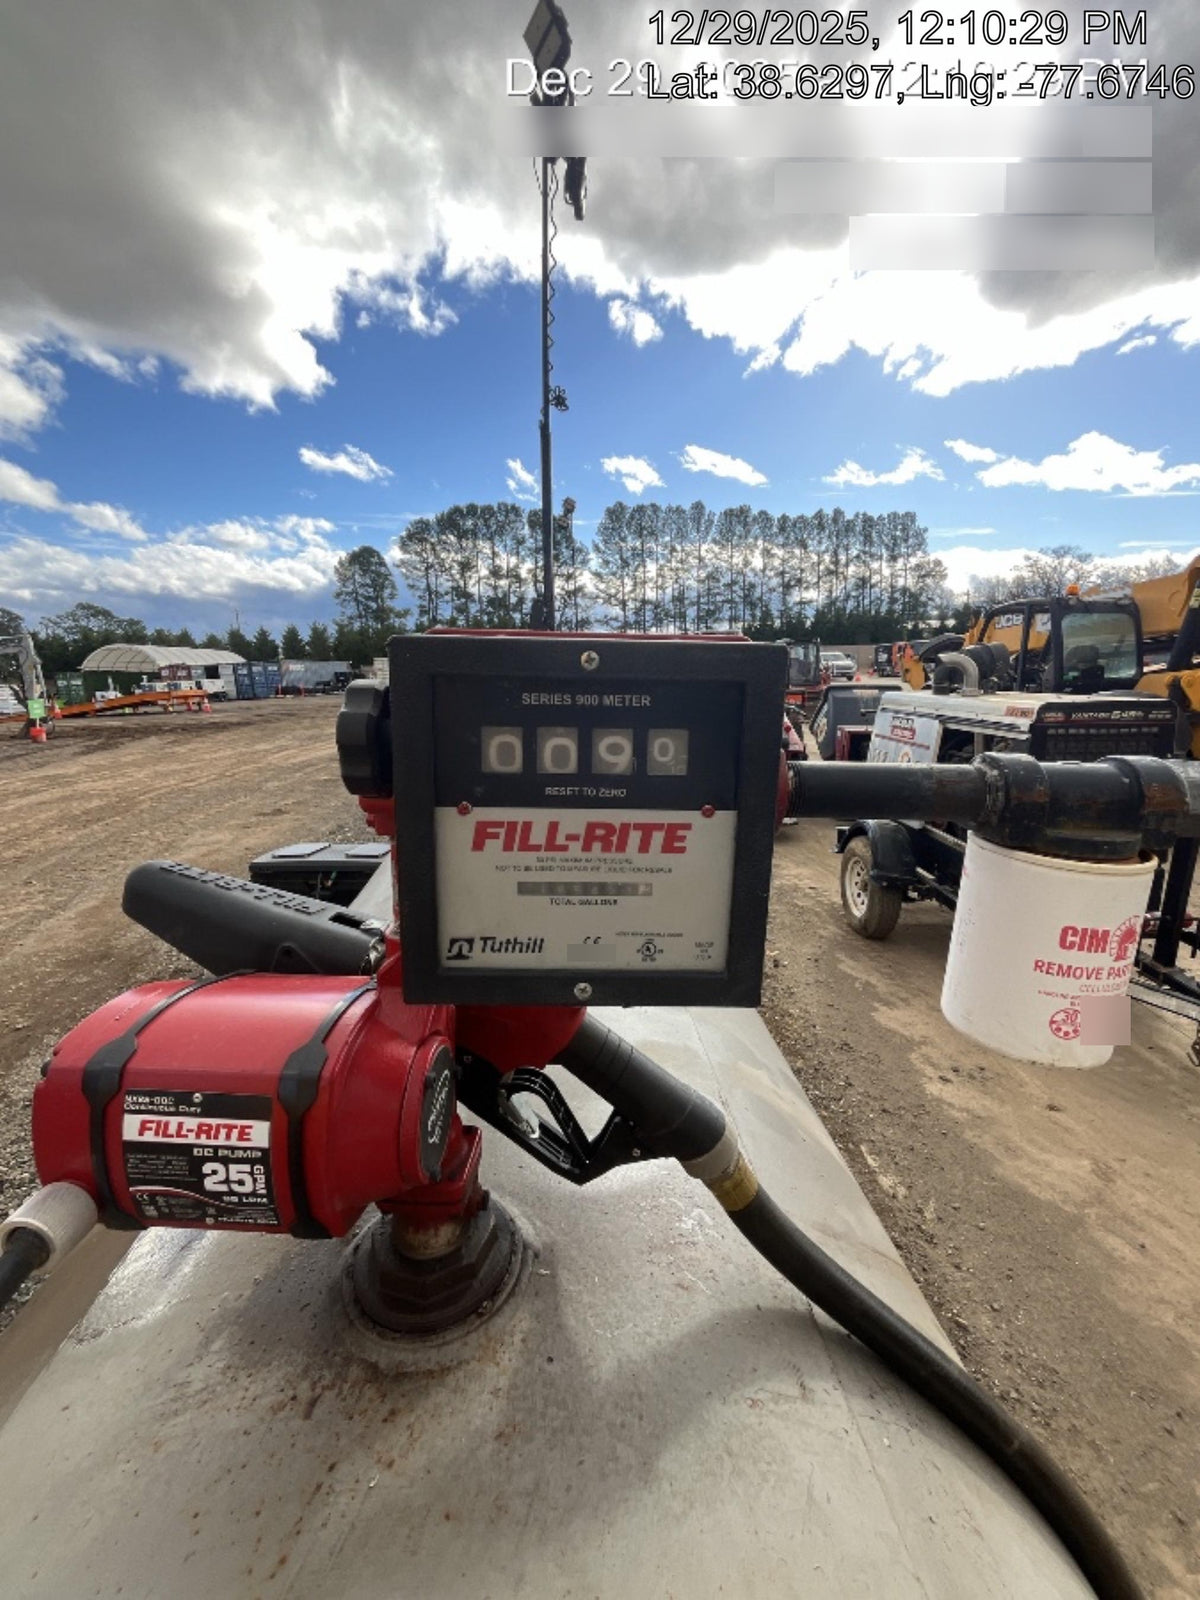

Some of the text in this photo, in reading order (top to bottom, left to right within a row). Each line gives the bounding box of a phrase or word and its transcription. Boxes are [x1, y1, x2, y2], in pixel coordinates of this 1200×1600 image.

[521, 692, 652, 707] SERIES 900 METER
[582, 787, 597, 797] TO
[470, 820, 693, 855] FILL-RITE
[479, 936, 545, 954] Tuthill
[1033, 958, 1105, 981] REMOVE
[138, 1119, 254, 1142] FILL-RITE
[192, 1147, 263, 1159] DC PUMP
[201, 1161, 254, 1194] 25
[253, 1164, 268, 1195] GPM
